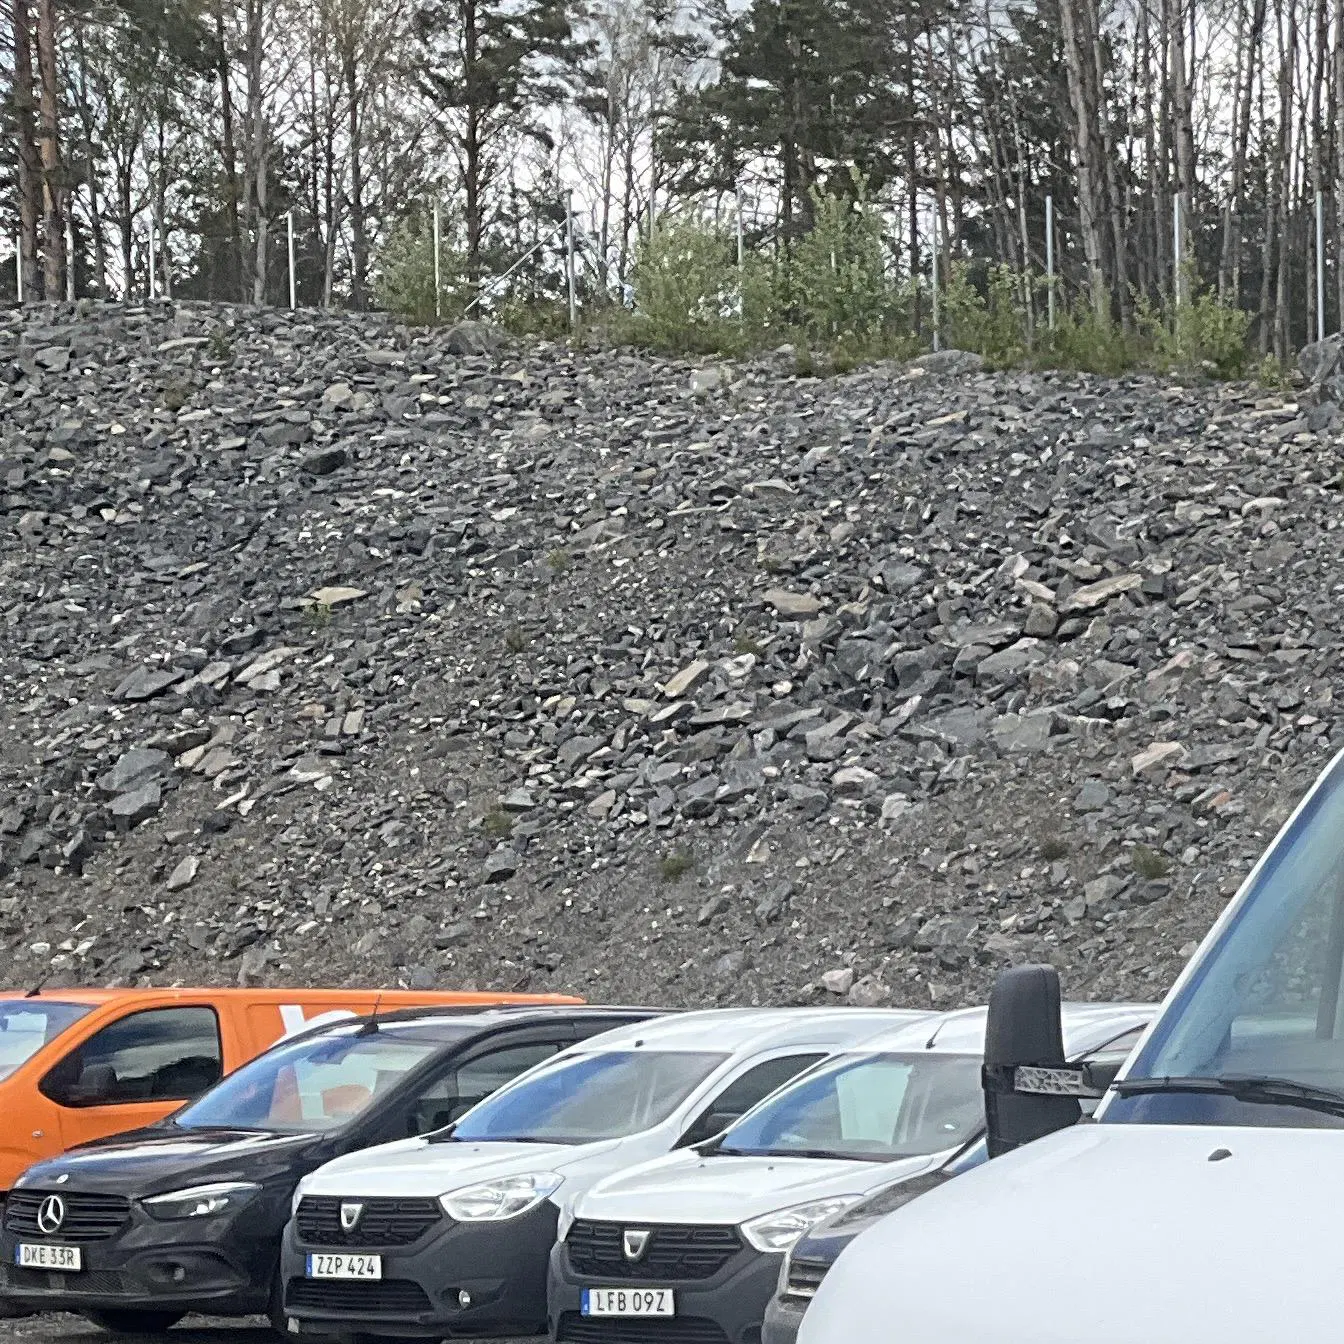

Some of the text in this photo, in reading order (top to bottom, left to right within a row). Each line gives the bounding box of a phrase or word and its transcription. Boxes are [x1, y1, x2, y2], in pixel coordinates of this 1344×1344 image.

[317, 1256, 375, 1275] ZZP 424
[596, 1291, 665, 1312] LFB 09Z
